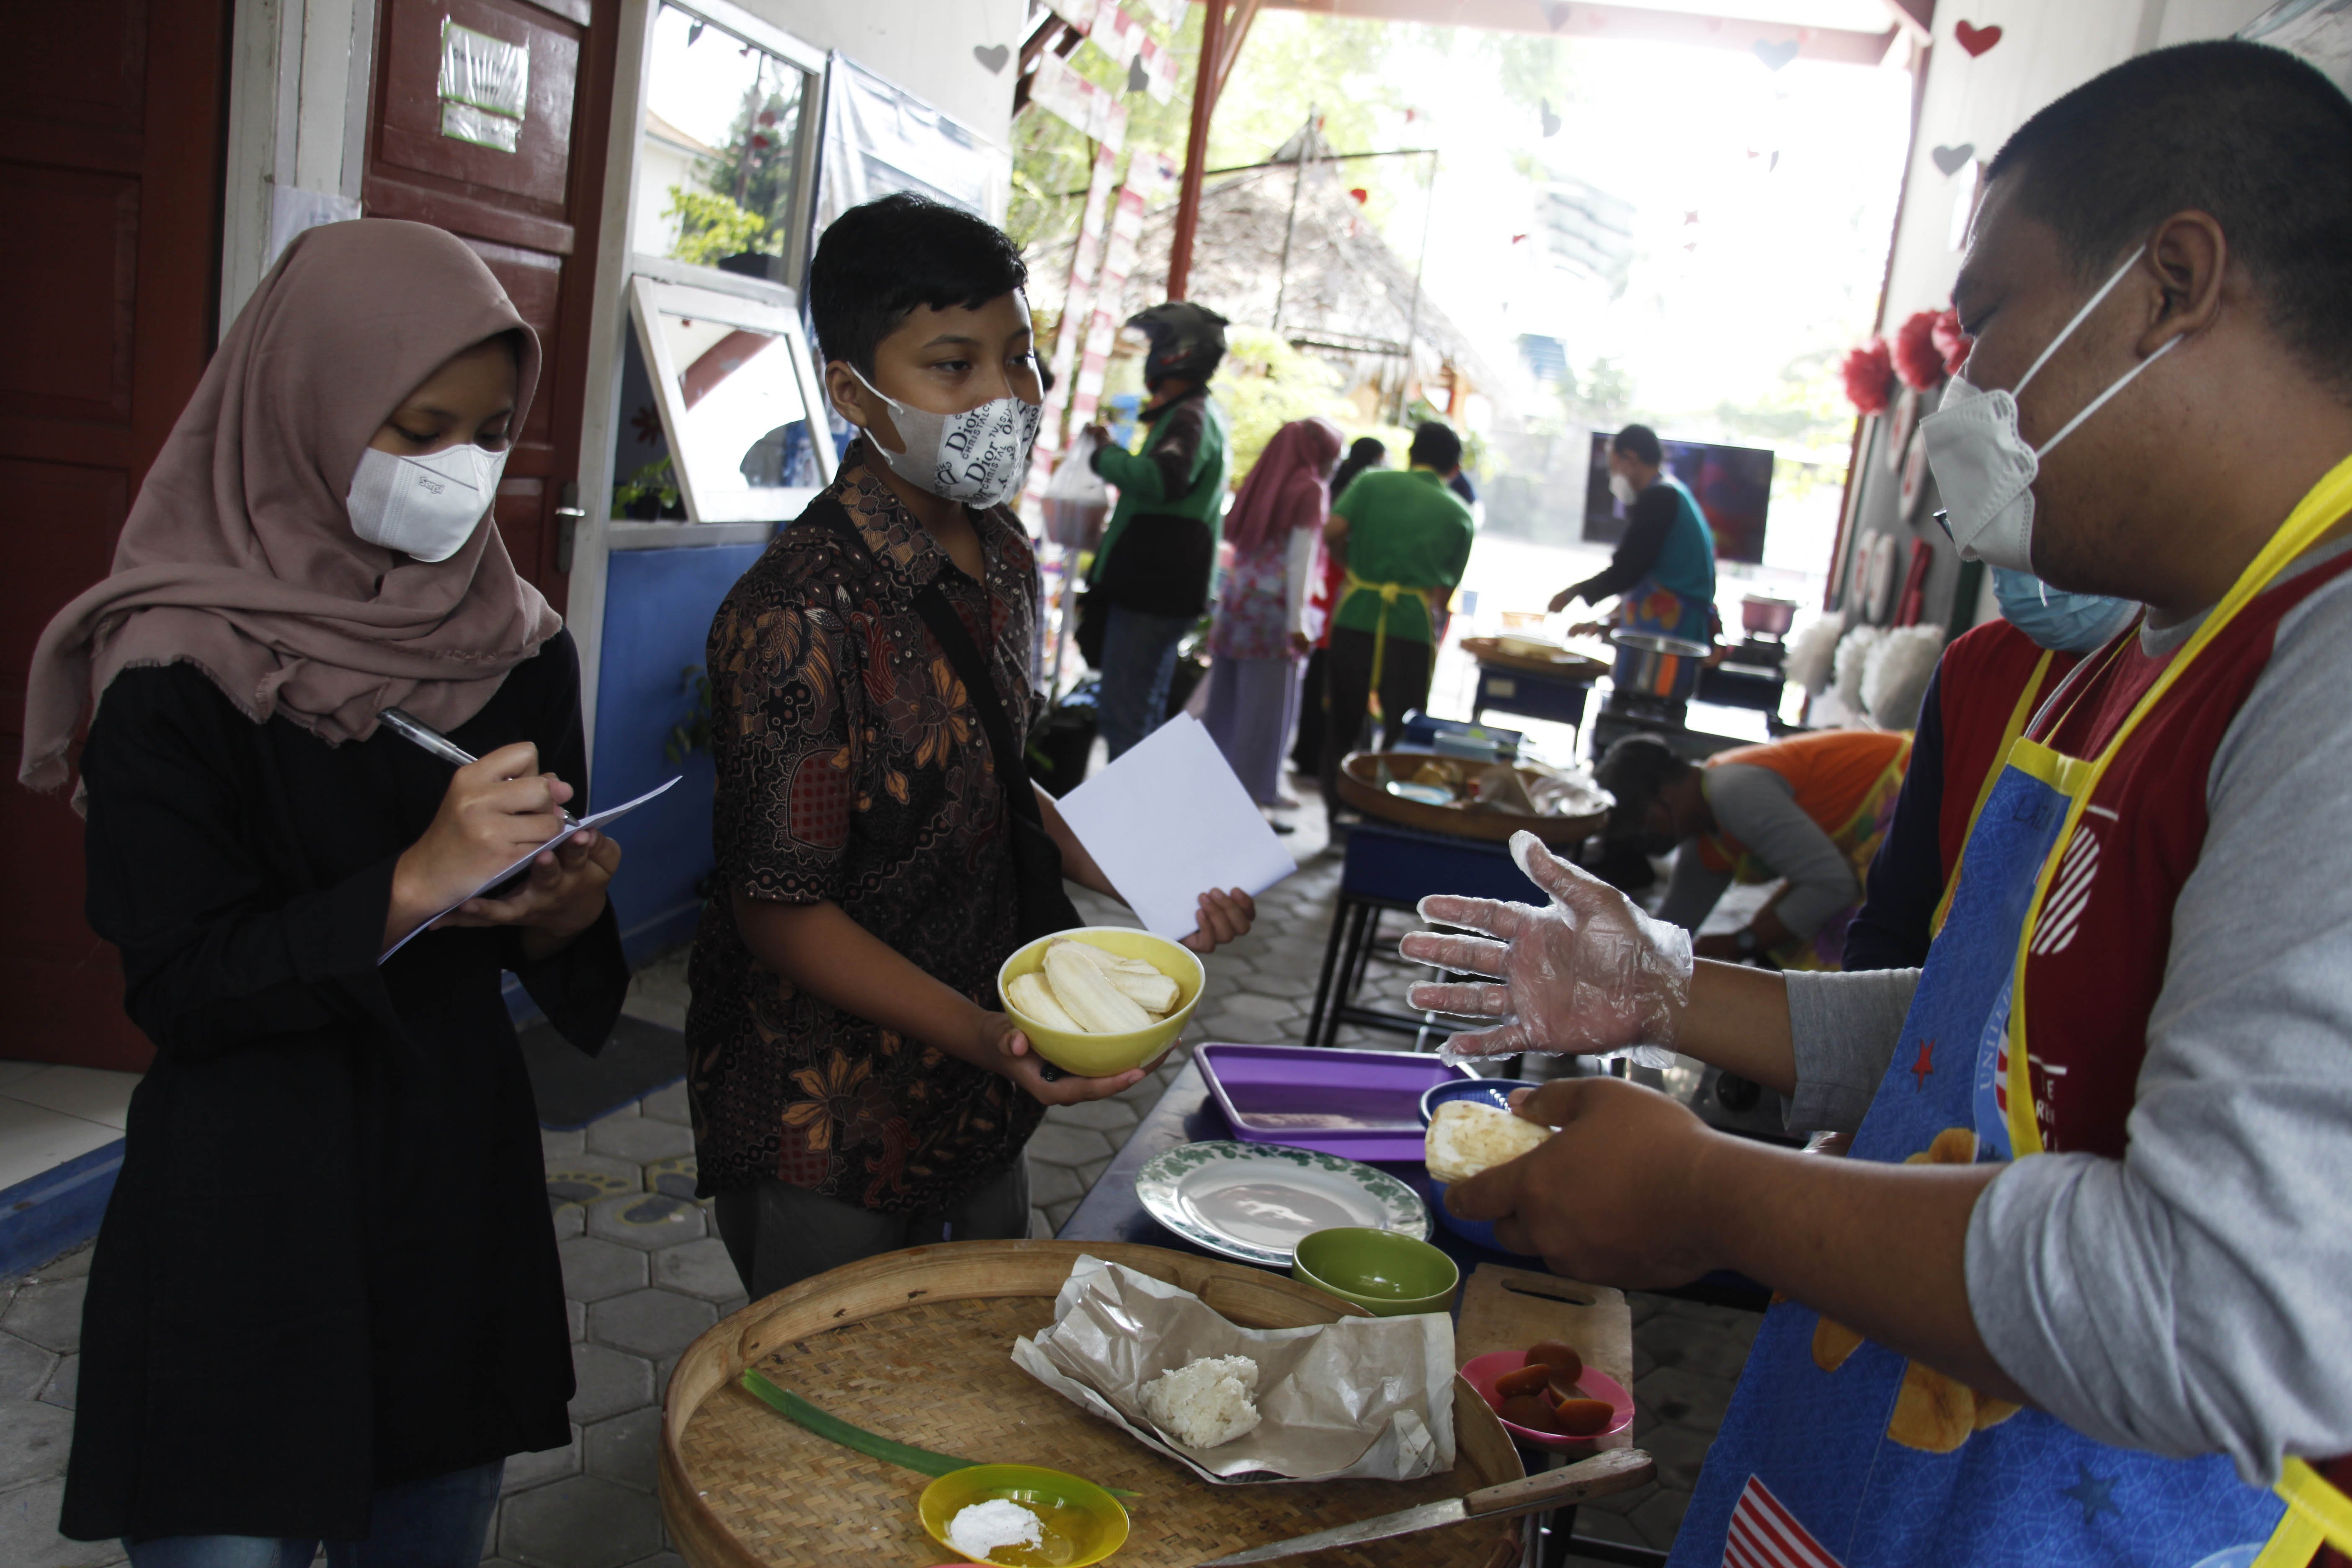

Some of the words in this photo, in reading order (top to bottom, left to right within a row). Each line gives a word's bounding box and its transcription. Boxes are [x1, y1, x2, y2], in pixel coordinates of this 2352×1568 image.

[945, 410, 980, 455] Dior
[962, 413, 990, 460] CHRISTAL
[964, 441, 998, 485] Dior
[982, 446, 1007, 490] CHRISTAL
[419, 477, 445, 494] Sensi
